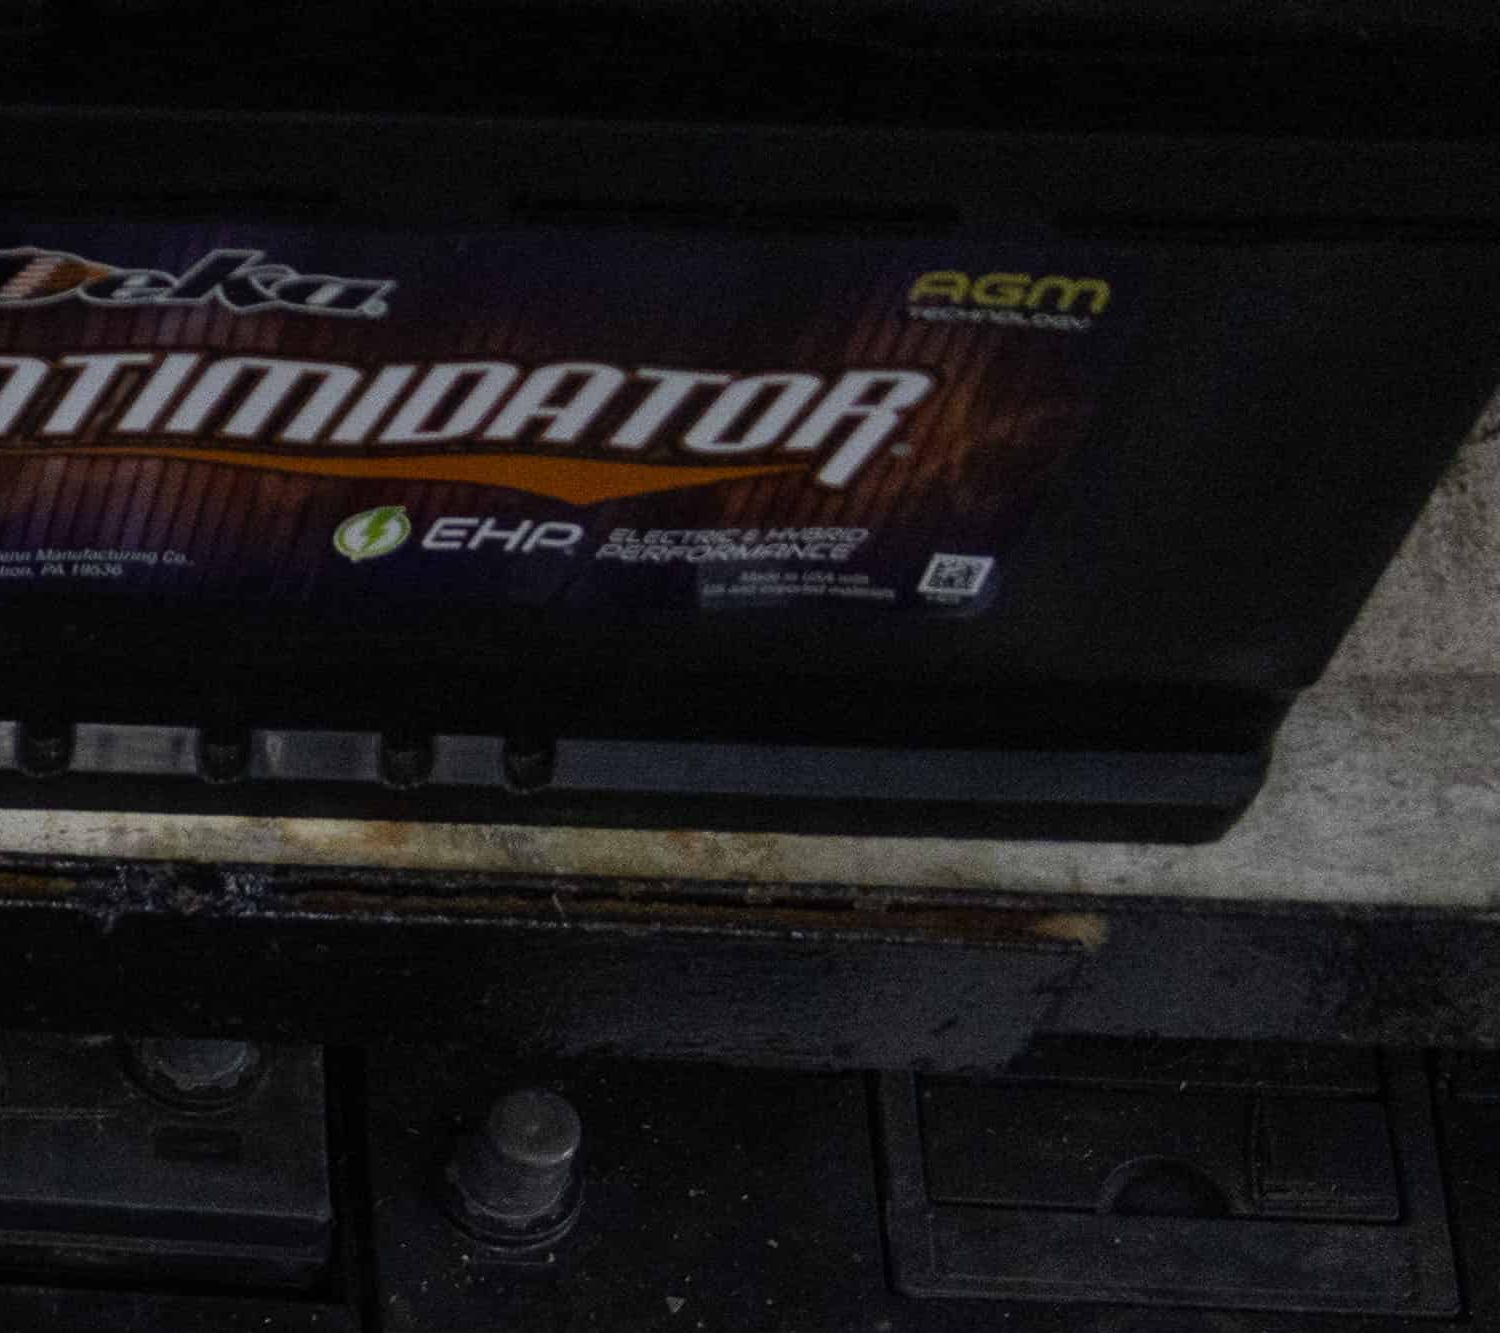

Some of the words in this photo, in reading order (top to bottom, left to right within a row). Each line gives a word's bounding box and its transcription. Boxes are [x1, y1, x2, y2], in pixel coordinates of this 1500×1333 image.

[908, 271, 1111, 315] AGM
[420, 515, 585, 552] EHP
[35, 549, 157, 566] Manufacturing
[40, 562, 66, 576] PA
